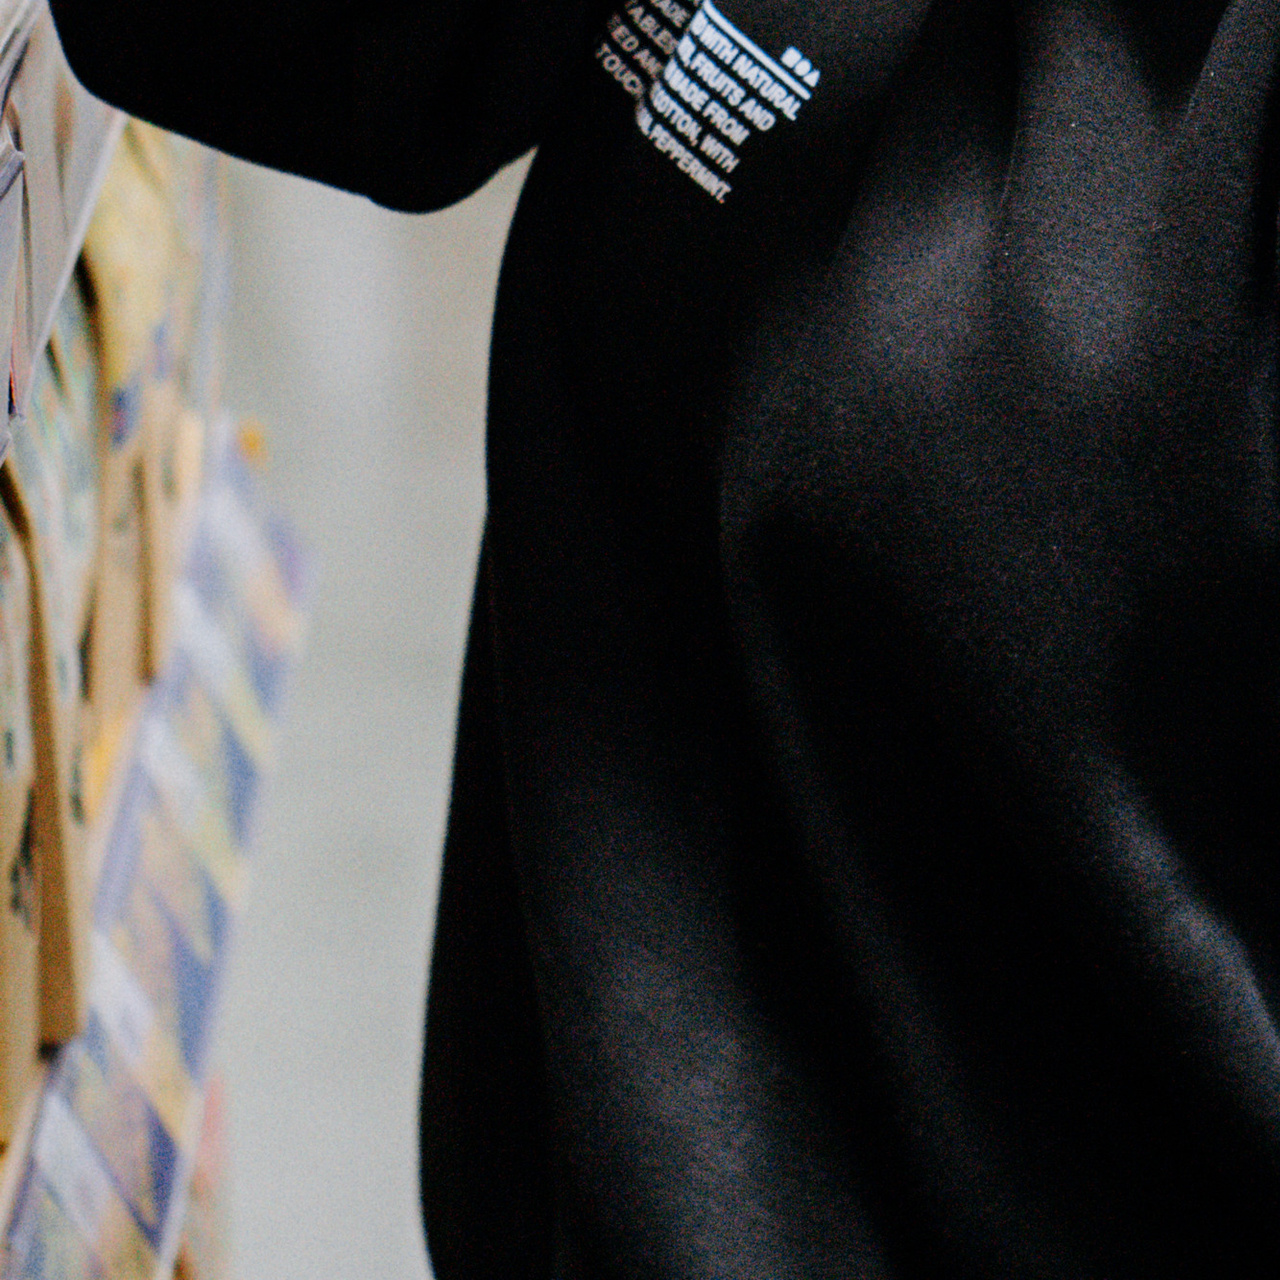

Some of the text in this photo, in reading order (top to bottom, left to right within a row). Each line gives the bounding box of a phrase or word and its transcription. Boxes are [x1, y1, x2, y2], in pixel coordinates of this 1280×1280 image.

[690, 51, 746, 107] FRUITS
[738, 97, 776, 132] AND
[699, 23, 740, 65] WITH
[731, 53, 802, 121] NATURAL
[648, 123, 732, 204] PEPPERMINT.
[700, 134, 741, 174] WITH
[702, 100, 750, 146] FROM
